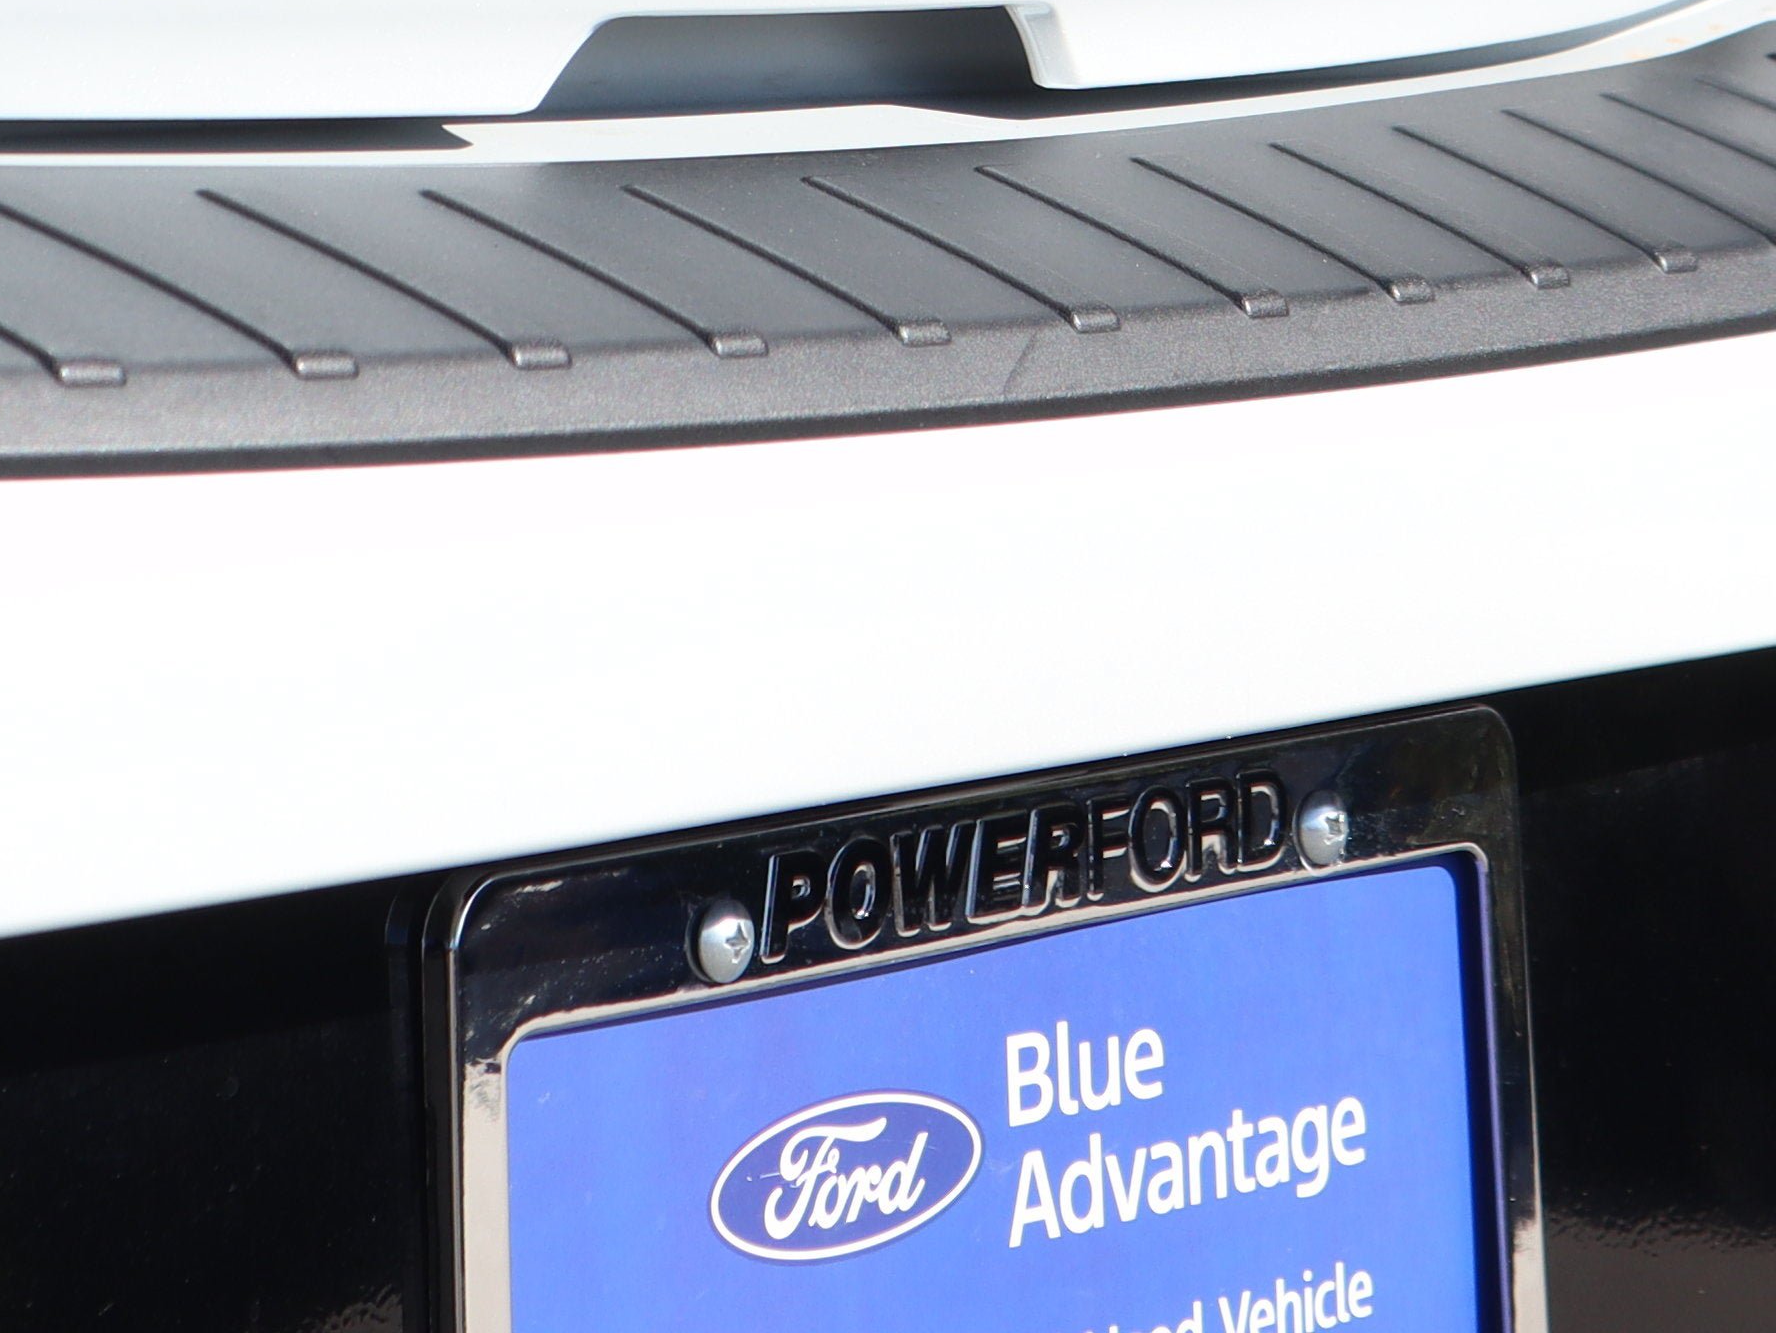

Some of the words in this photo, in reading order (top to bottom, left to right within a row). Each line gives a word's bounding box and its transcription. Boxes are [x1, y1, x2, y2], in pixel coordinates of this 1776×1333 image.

[1005, 1019, 1165, 1129] Blue
[763, 1116, 929, 1239] Ford
[1008, 1096, 1367, 1248] Advantage
[1218, 1260, 1374, 1333] Vehicle
